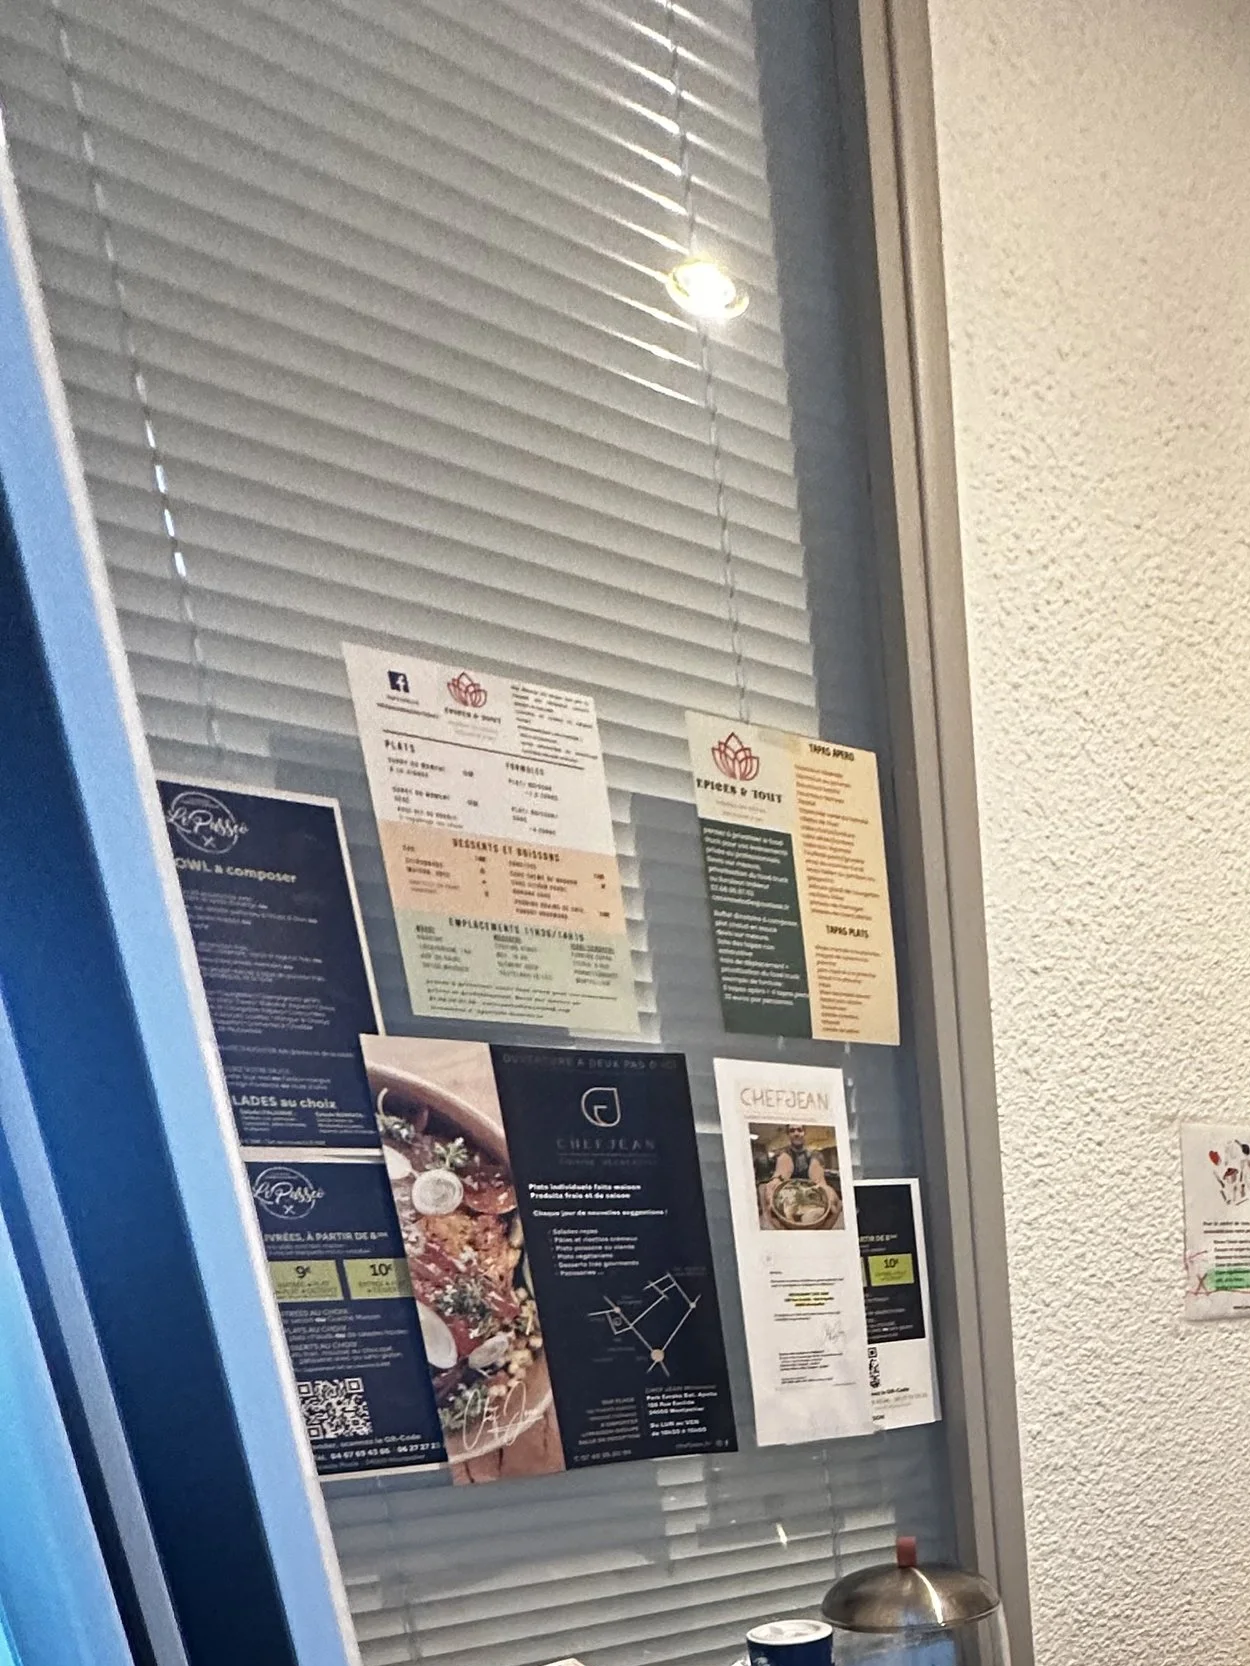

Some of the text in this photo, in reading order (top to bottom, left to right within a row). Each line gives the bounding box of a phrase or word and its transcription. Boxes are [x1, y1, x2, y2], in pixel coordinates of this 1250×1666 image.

[175, 857, 212, 873] OWL
[226, 866, 297, 883] composer
[232, 1095, 337, 1109] LADES au choix
[740, 1088, 828, 1110] CHEFJEAN
[316, 1232, 352, 1240] PARTIR
[355, 1232, 368, 1240] DE
